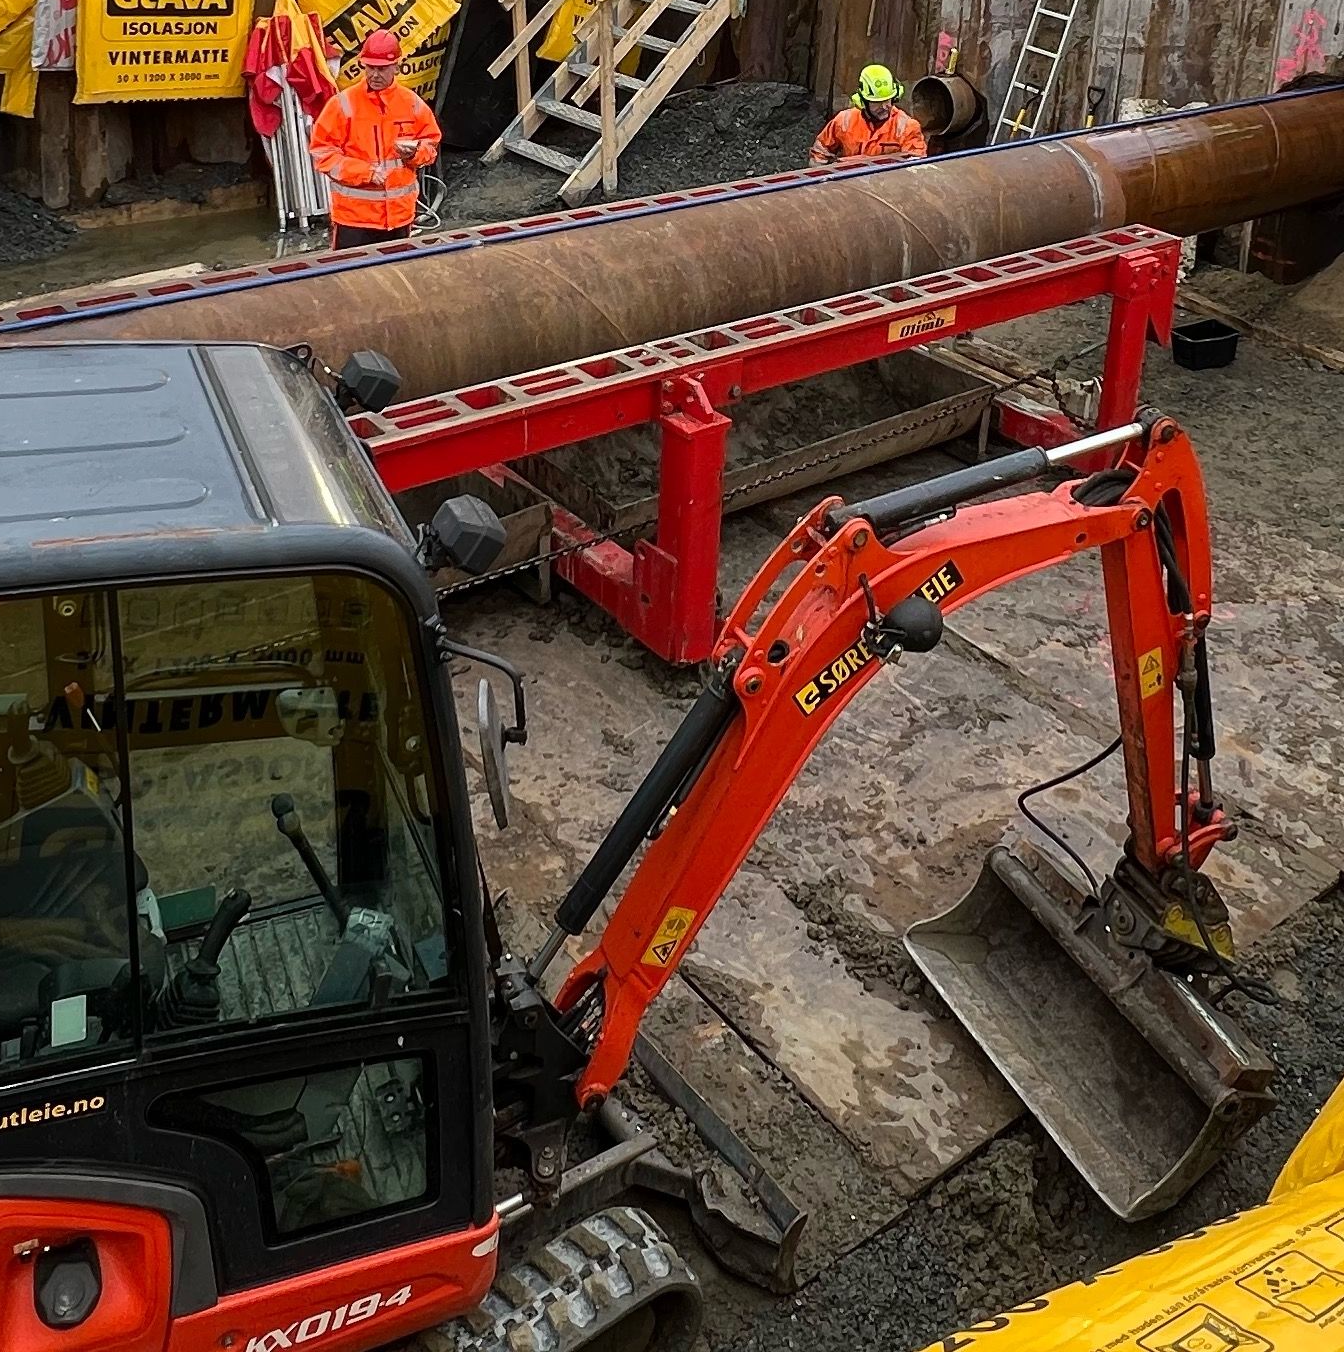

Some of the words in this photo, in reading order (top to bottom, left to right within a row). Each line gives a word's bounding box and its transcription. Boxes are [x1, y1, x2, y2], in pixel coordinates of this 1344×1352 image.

[122, 22, 218, 36] ISOLASJON
[108, 49, 229, 65] VINTERMATTE
[899, 317, 946, 339] Olimb
